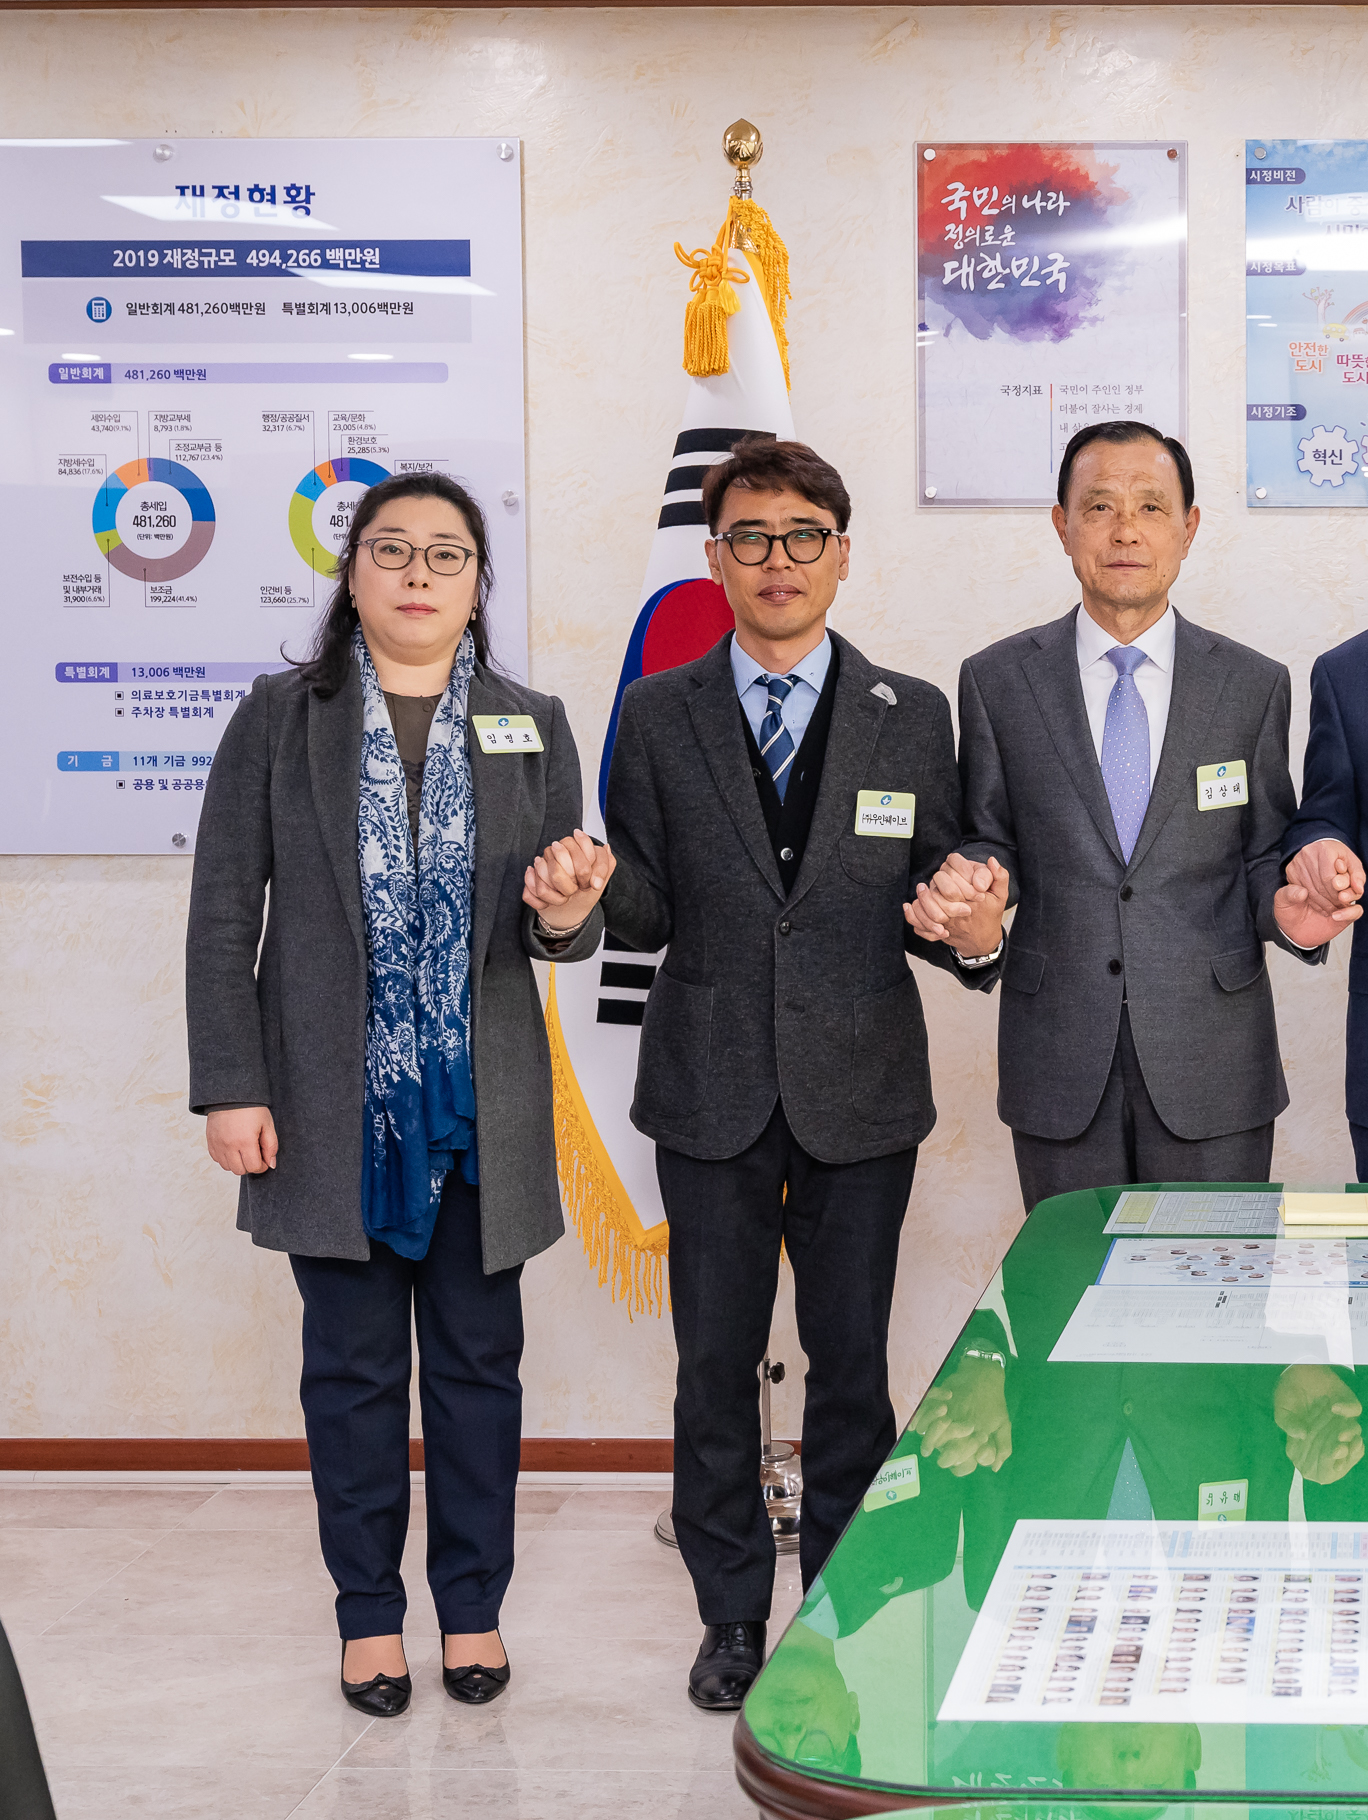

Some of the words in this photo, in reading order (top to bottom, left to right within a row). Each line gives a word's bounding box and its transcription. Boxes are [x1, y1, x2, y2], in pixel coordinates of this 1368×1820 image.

[1250, 170, 1296, 182] 시정비전
[175, 183, 316, 218] 재정현황
[940, 182, 1016, 220] 국민의
[1022, 190, 1070, 216] 나라
[1285, 196, 1339, 216] 사람이
[944, 223, 1016, 250] 정의로운
[113, 249, 159, 268] 2019
[163, 248, 237, 268] 재정규모
[246, 249, 321, 270] 494,266
[326, 248, 380, 269] 백만원
[942, 252, 1070, 293] 대한민국
[1250, 261, 1296, 272] 시정목표
[125, 301, 176, 317] 일반회계
[281, 301, 332, 317] 특별회계
[1289, 342, 1328, 358] 안전한
[1295, 360, 1322, 373] 도시
[58, 366, 104, 380] 일반회계
[124, 369, 171, 382] 481,260
[173, 368, 207, 382] 백만원
[1000, 384, 1043, 396] 국정지표
[1059, 384, 1088, 396] 국민이
[1092, 384, 1121, 396] 주인인
[1124, 384, 1144, 396] 정부
[1059, 404, 1088, 414] 더불어
[1092, 404, 1120, 414] 잘사는
[1124, 404, 1143, 414] 경제
[1250, 406, 1297, 418] 시정기조
[91, 414, 120, 423] 세외수입
[154, 414, 191, 423] 지방교부세
[333, 414, 366, 422] 교육/문화
[348, 436, 378, 445] 환경보호
[175, 443, 212, 452] 조정교부금
[214, 443, 222, 452] 등
[58, 458, 94, 467] 지방세수입
[1312, 449, 1343, 466] 혁신
[400, 462, 432, 471] 복지/보건
[140, 501, 167, 512] 총세입
[132, 515, 176, 528] 481,260
[63, 574, 92, 582] 보전수입
[94, 574, 102, 582] 등
[63, 586, 71, 594] 및
[72, 586, 102, 594] 내부거래
[150, 586, 172, 594] 보조금
[260, 586, 282, 594] 인건비
[284, 586, 292, 594] 등
[64, 666, 110, 679] 특별회계
[131, 667, 170, 679] 13,006
[172, 666, 206, 678] 백만원
[130, 690, 246, 702] 의료보호기금특별회계
[130, 706, 165, 718] 주차장
[168, 706, 214, 718] 특별회계
[132, 756, 158, 768] 11개
[164, 756, 186, 768] 기금
[132, 778, 155, 790] 공용
[158, 778, 168, 790] 및
[172, 778, 207, 790] 공공용
